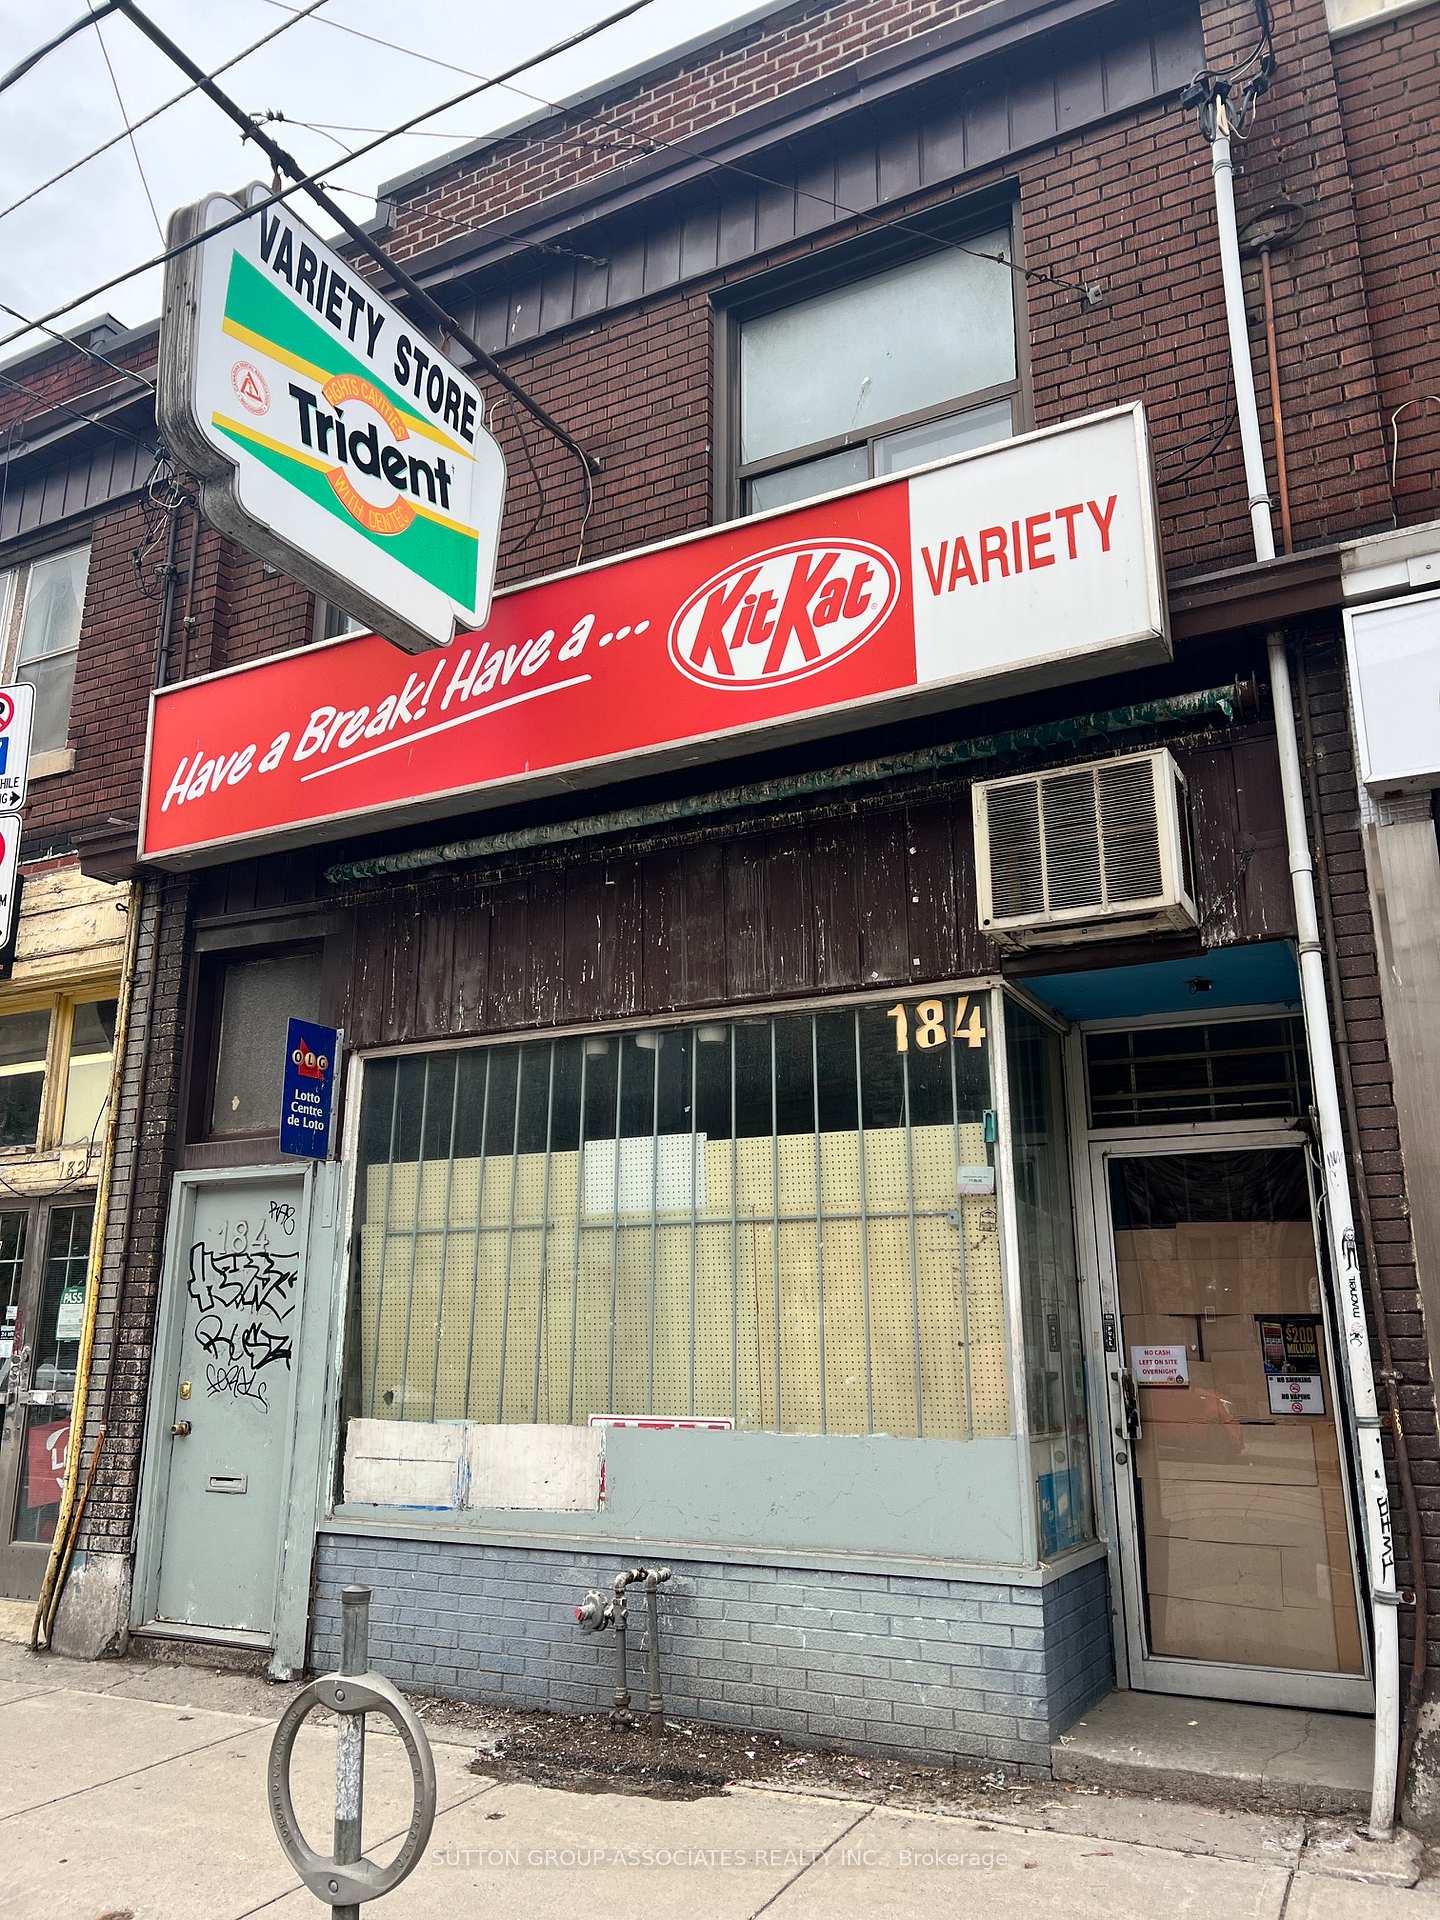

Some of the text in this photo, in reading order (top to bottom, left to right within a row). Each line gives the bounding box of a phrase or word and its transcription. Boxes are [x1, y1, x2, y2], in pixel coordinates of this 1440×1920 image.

[259, 205, 385, 360] VARIETY
[394, 334, 478, 445] STORE
[360, 381, 407, 438] CAVITIES
[288, 382, 453, 511] Trident
[334, 475, 364, 518] WITH
[920, 494, 1118, 597] VARIETY
[161, 750, 253, 813] Have
[258, 731, 291, 773] a
[291, 657, 447, 763] Break!
[440, 627, 556, 711] Have
[0, 776, 20, 789] HILE
[886, 995, 987, 1053] 184
[293, 1050, 328, 1070] OLG
[290, 1101, 323, 1117] Centre
[294, 1088, 321, 1104] Lotto
[287, 1114, 325, 1131] de Loto
[218, 1219, 270, 1254] 184
[63, 1292, 83, 1304] PASS
[1286, 1326, 1314, 1343] $200
[1287, 1343, 1316, 1354] MILLION
